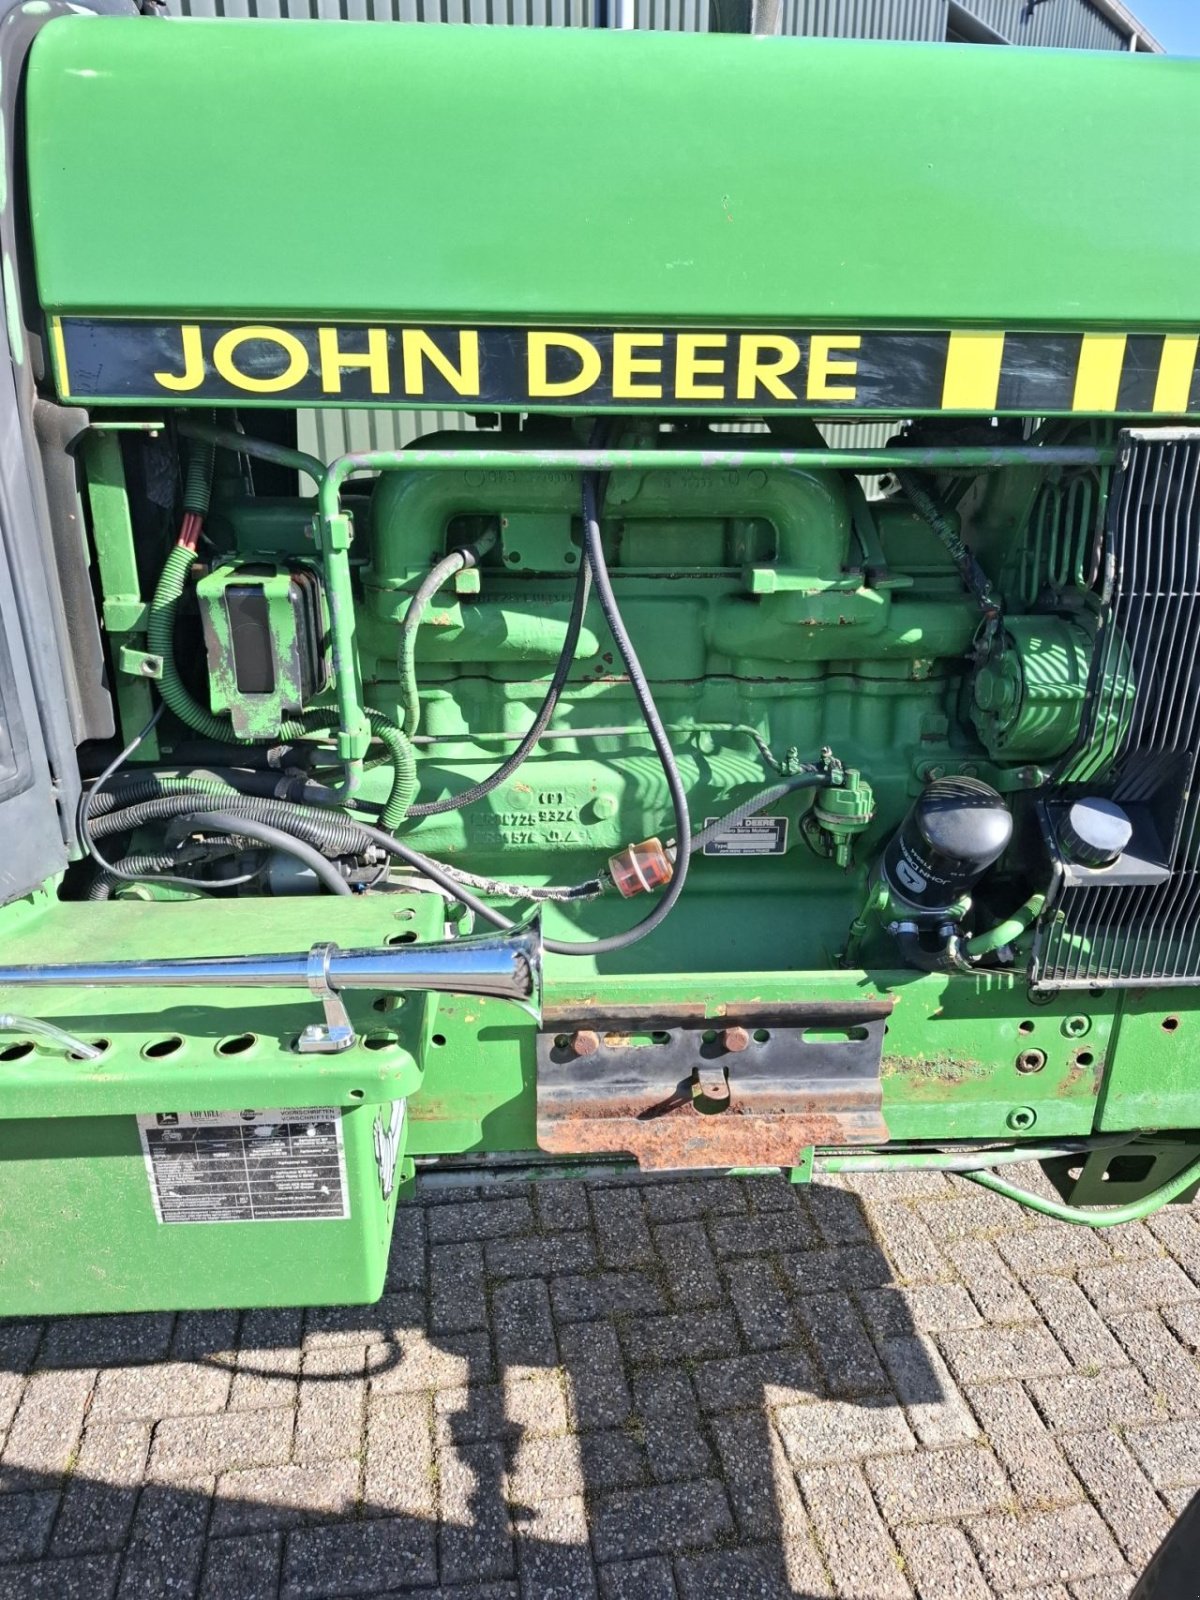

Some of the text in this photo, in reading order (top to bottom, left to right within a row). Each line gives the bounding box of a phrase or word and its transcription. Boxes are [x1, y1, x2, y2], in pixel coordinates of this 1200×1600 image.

[154, 324, 863, 400] JOHN DEERE
[745, 819, 776, 827] DEERE
[918, 868, 952, 885] JOHN
